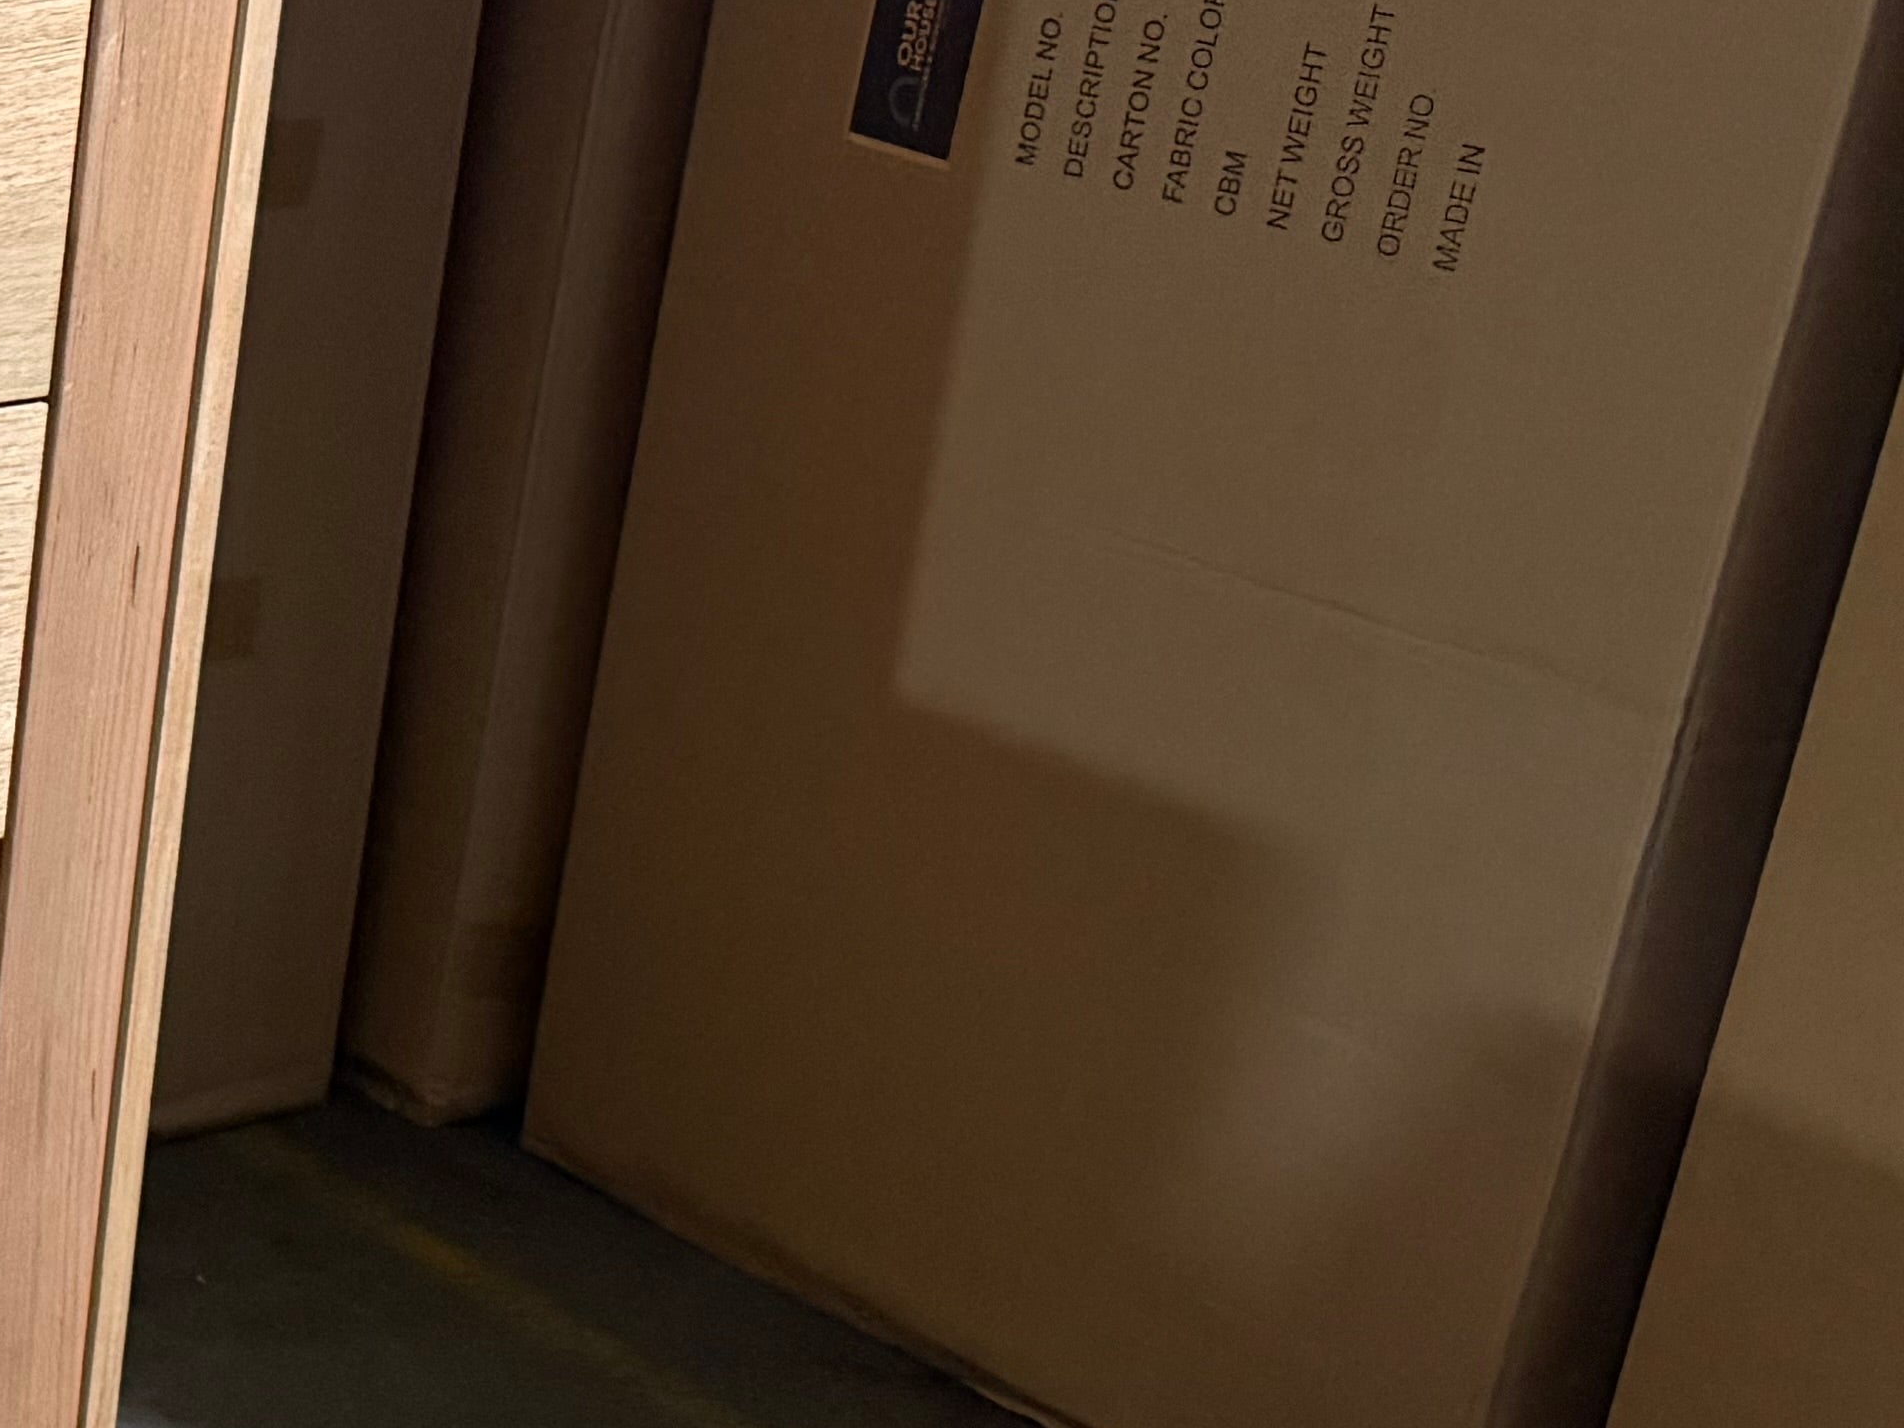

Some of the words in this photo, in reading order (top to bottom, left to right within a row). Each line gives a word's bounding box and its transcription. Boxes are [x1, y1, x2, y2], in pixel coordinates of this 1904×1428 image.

[1015, 68, 1053, 166] MODEL
[1112, 69, 1155, 191] CARTON
[1137, 14, 1168, 64] NO.
[1161, 97, 1204, 204] FABRIC
[1281, 40, 1328, 163] WEIGHT
[1321, 135, 1365, 243] GROSS
[1346, 2, 1396, 127] WEIGHT
[1214, 150, 1248, 216] CBM
[1266, 167, 1299, 231] NET
[1377, 146, 1423, 257] ORDER
[1432, 180, 1477, 272] MADE
[1456, 143, 1486, 176] IN
